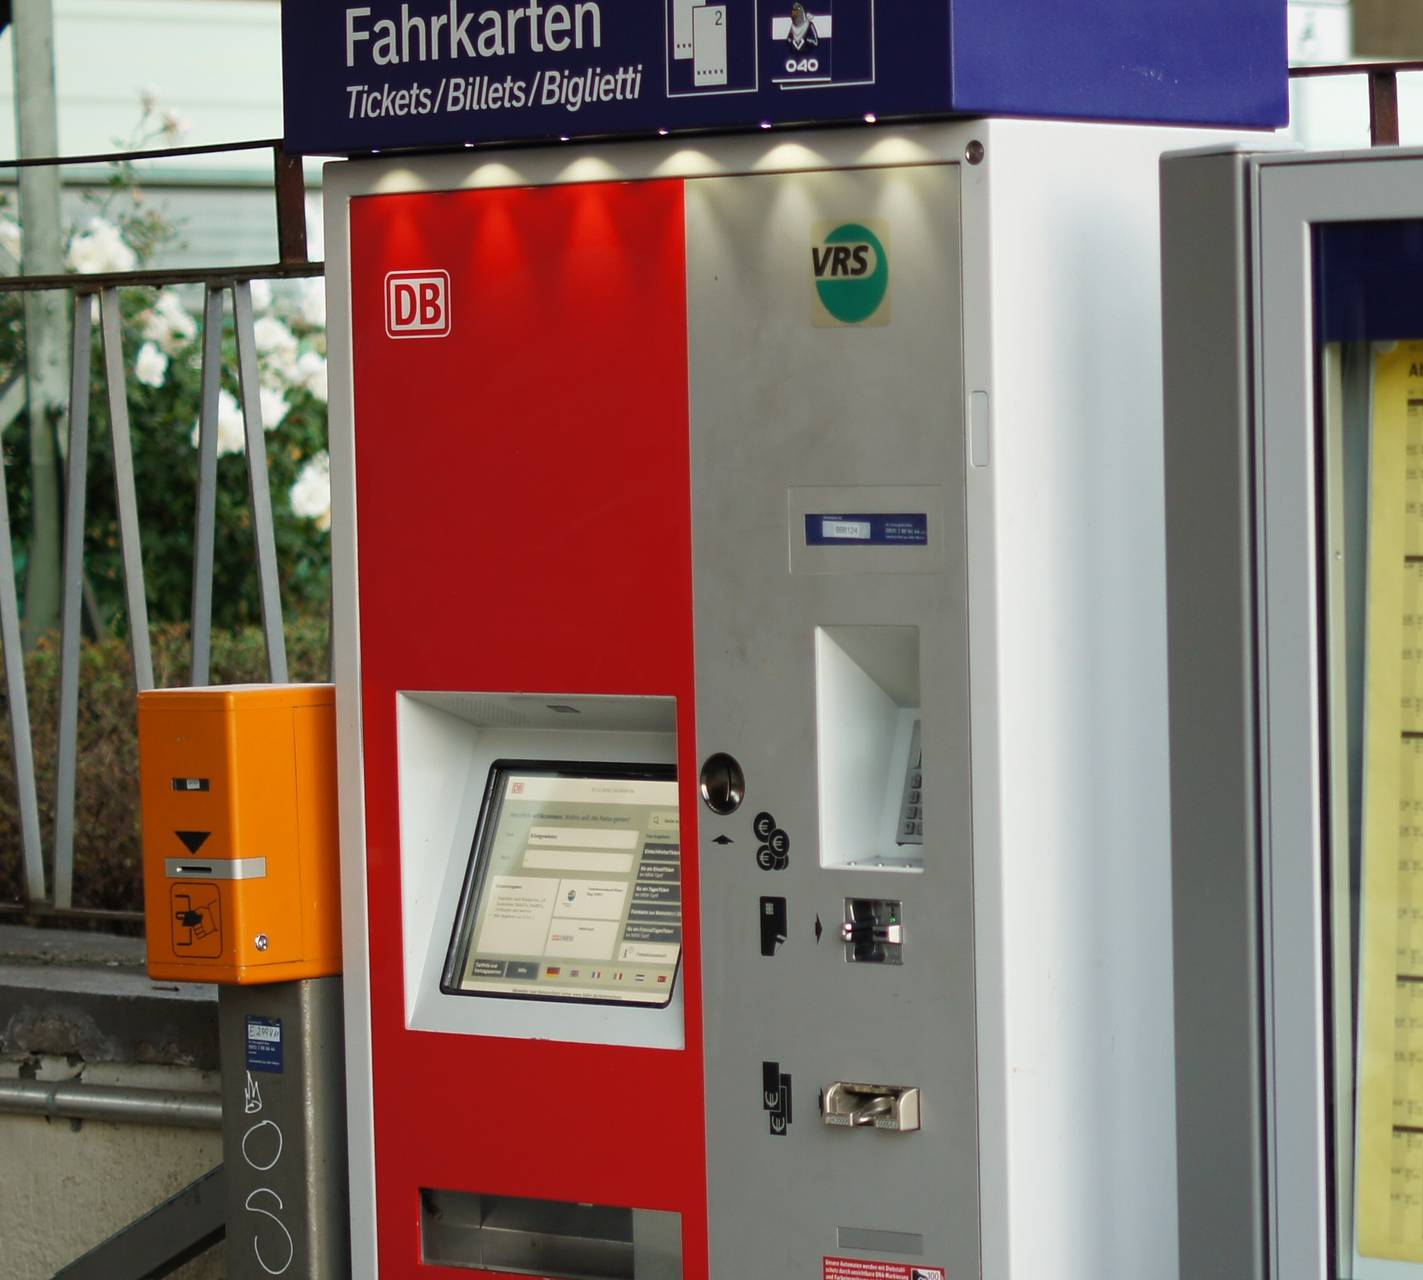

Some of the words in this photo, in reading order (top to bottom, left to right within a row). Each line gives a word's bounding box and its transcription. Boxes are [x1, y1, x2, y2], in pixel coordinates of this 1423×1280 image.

[346, 0, 601, 67] Fahrkarten
[812, 245, 869, 277] VRS
[394, 282, 442, 326] DB
